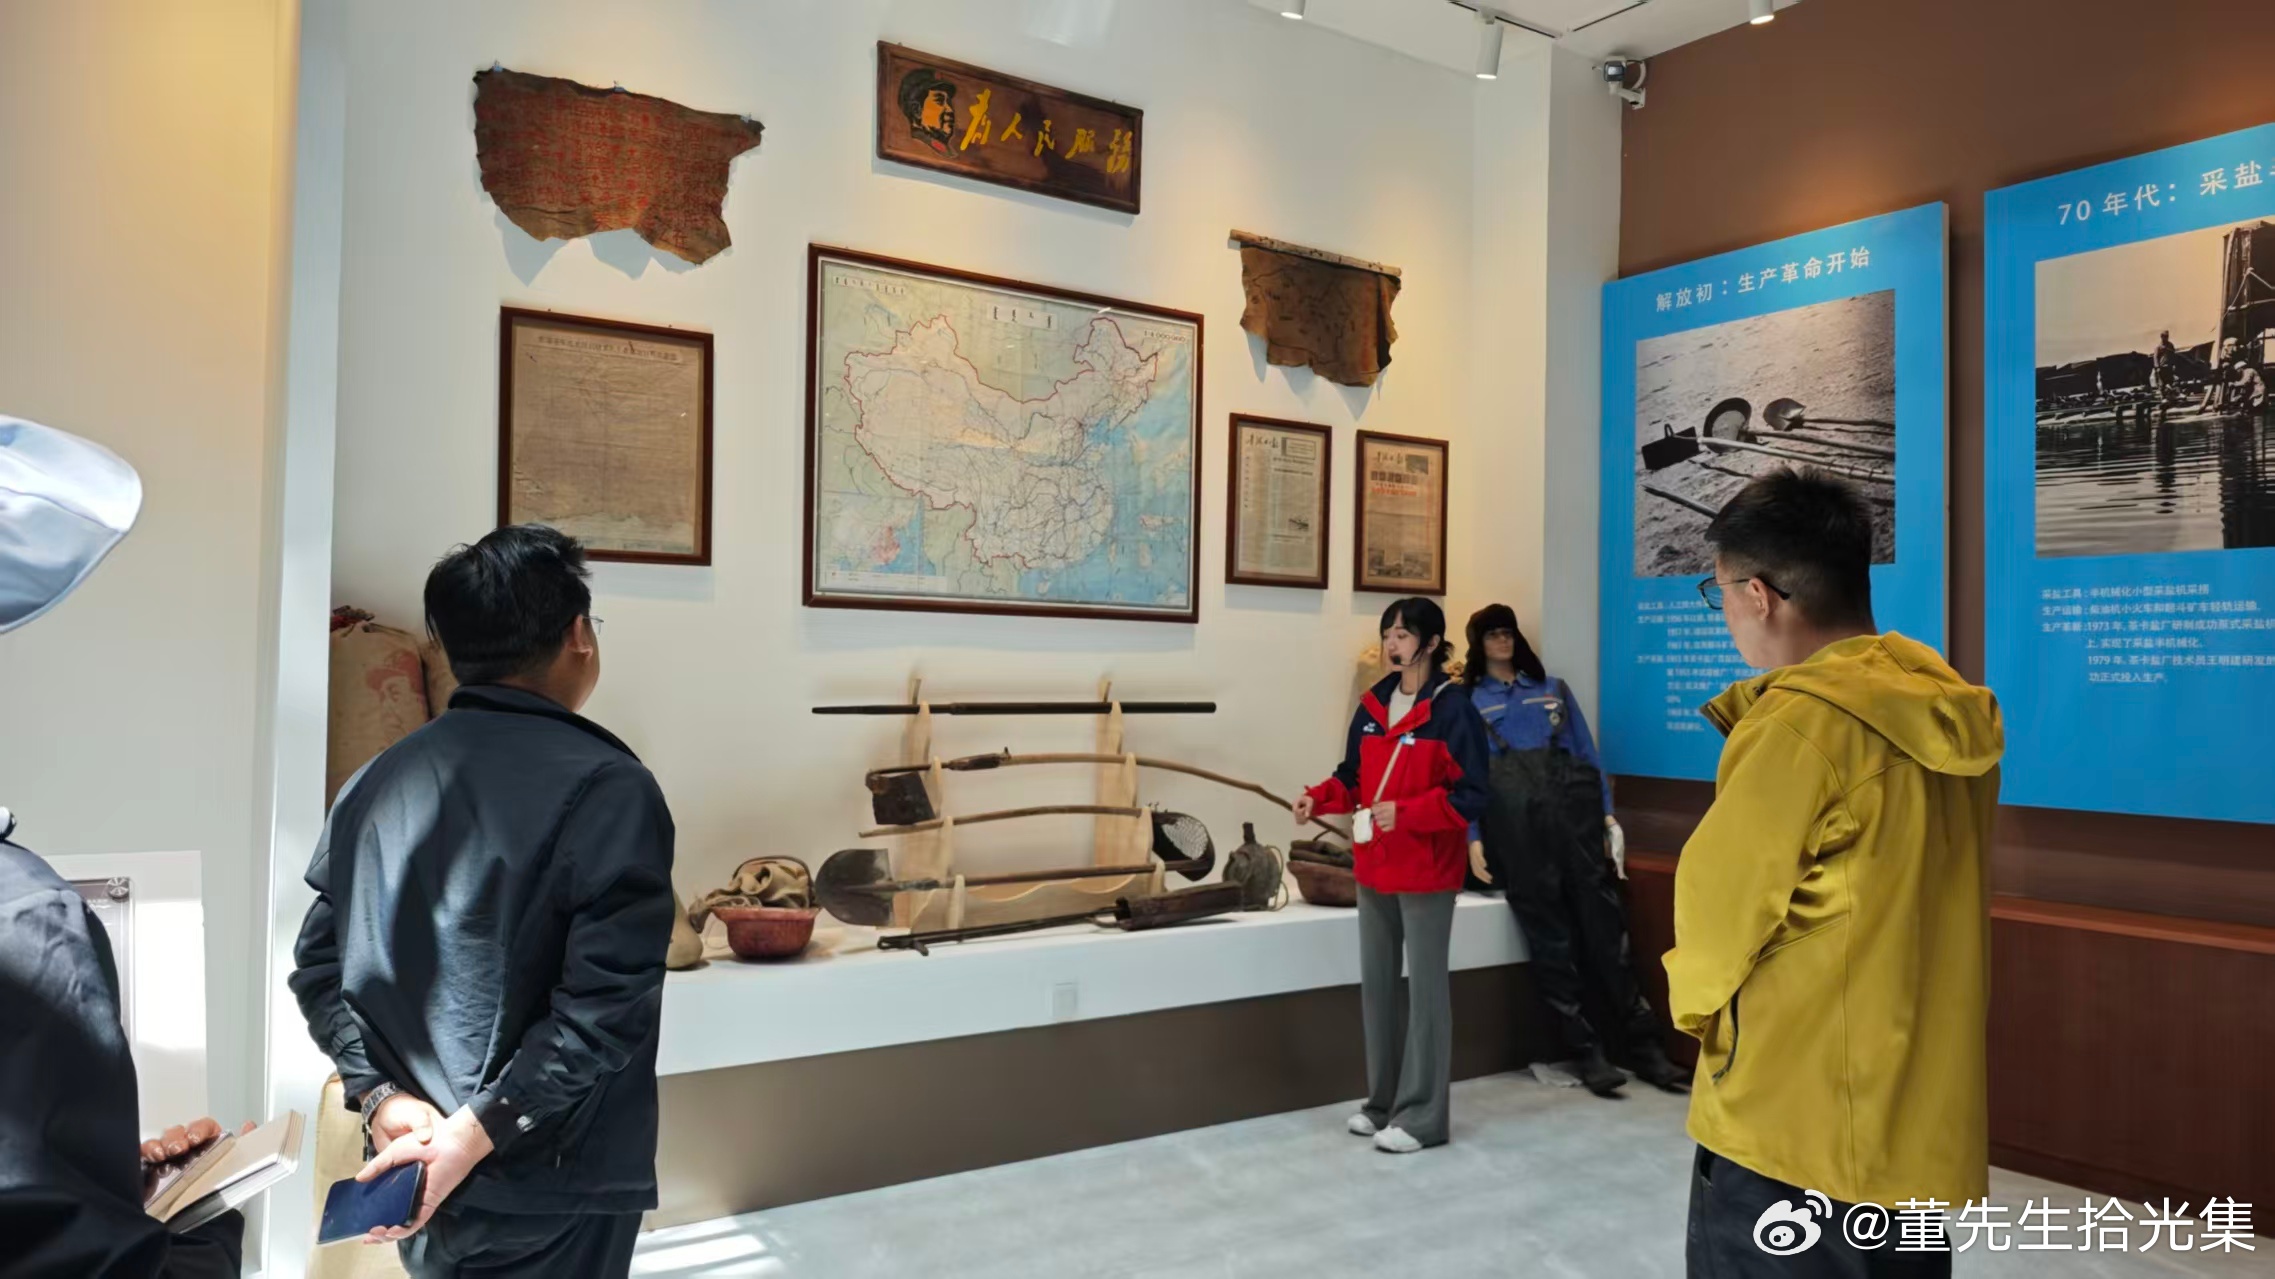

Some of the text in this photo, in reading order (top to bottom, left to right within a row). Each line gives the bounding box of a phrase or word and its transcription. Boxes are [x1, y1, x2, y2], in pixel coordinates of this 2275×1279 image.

[2058, 158, 2275, 226] 70年代：采盐
[1656, 245, 1871, 312] 解放初：生产革命开始
